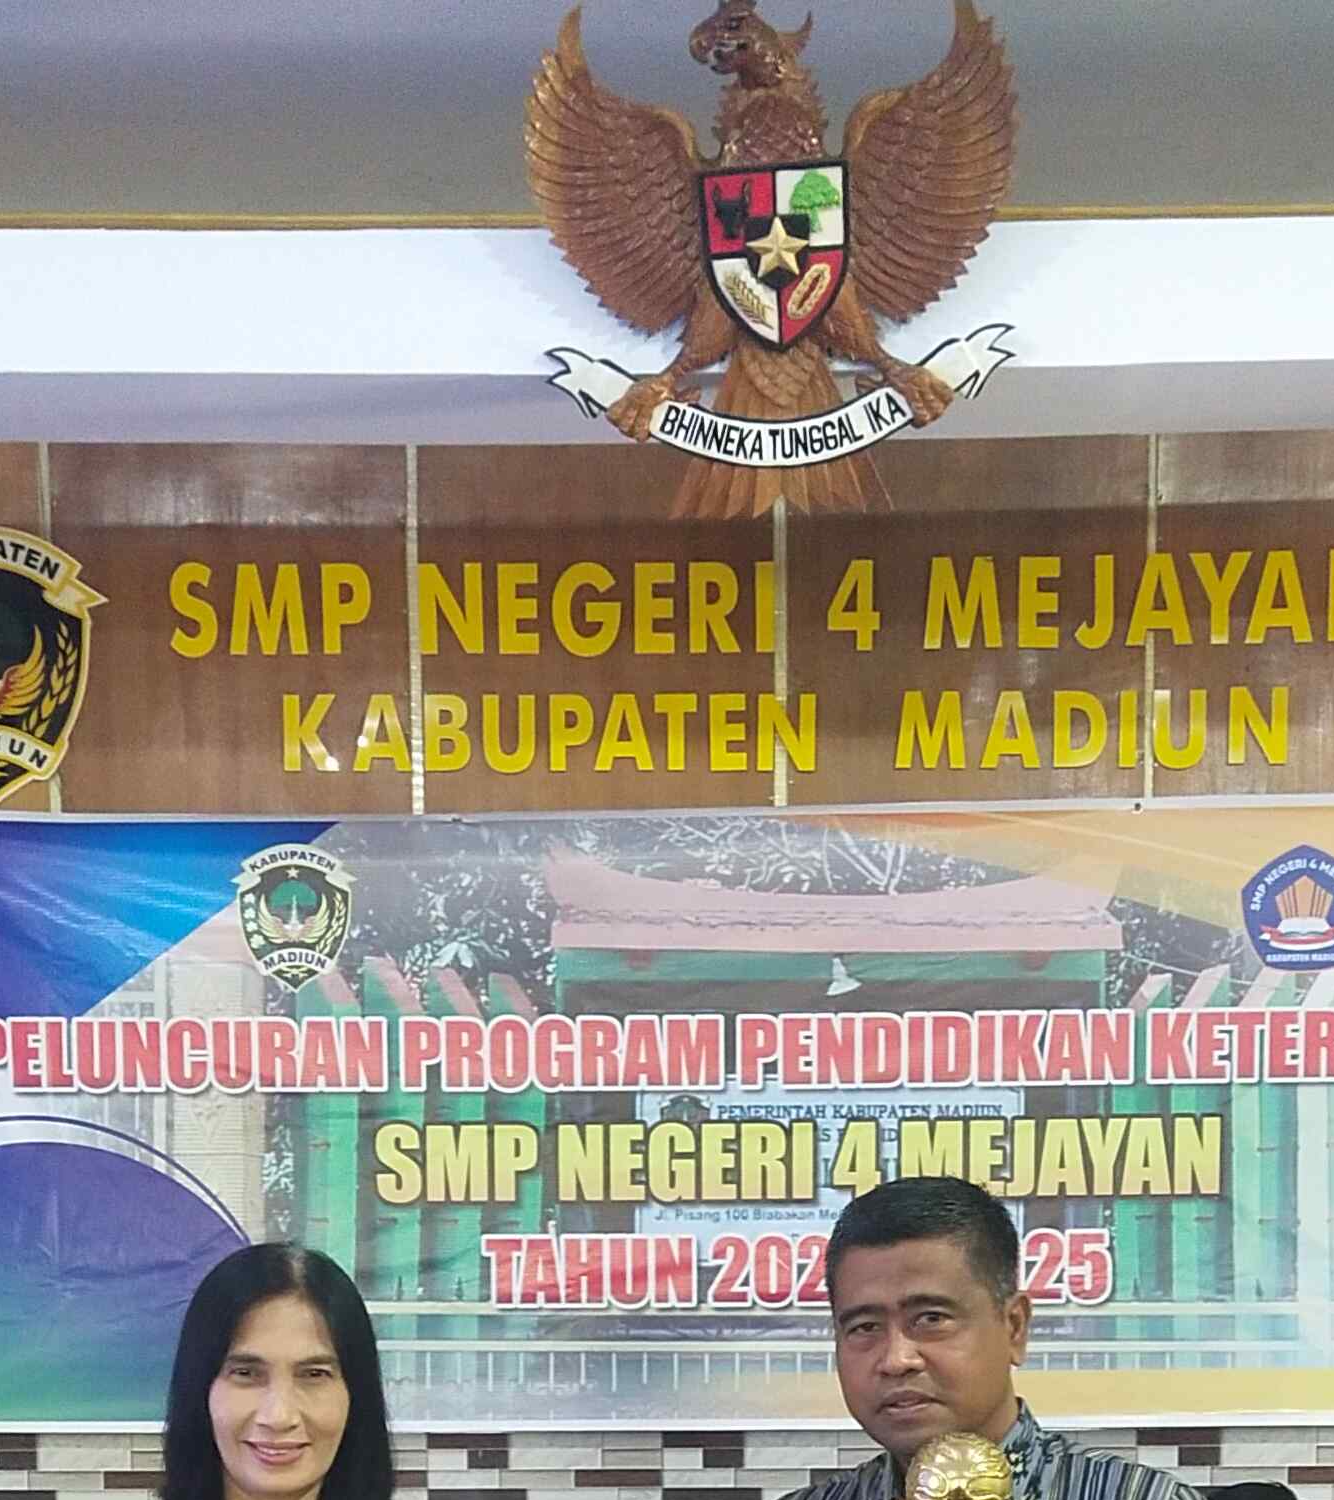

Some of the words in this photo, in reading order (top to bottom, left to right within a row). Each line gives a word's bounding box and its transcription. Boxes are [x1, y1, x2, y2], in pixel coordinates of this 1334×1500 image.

[659, 404, 764, 461] BHINNEKA
[768, 421, 864, 459] TUNGGAL
[864, 391, 908, 435] IKA
[169, 561, 372, 658] SMP
[418, 561, 775, 658] NEGERI
[826, 558, 881, 652] 4
[281, 692, 817, 772] KABUPATEN
[893, 685, 1290, 770] MADIUN
[248, 850, 336, 873] KABUPATEN
[1265, 858, 1308, 886] NEGERI
[262, 951, 327, 970] MADIUN
[399, 1013, 725, 1091] PROGRAM
[740, 1009, 1135, 1090] PENDIDIKAN
[716, 1104, 826, 1120] PEMERINTAH
[832, 1104, 932, 1119] KABUPATEN
[374, 1121, 539, 1204] SMP
[558, 1120, 815, 1203] NEGERI
[832, 1121, 883, 1199] 4
[898, 1115, 1224, 1200] MEJAYAN
[481, 1235, 696, 1311] TAHUN
